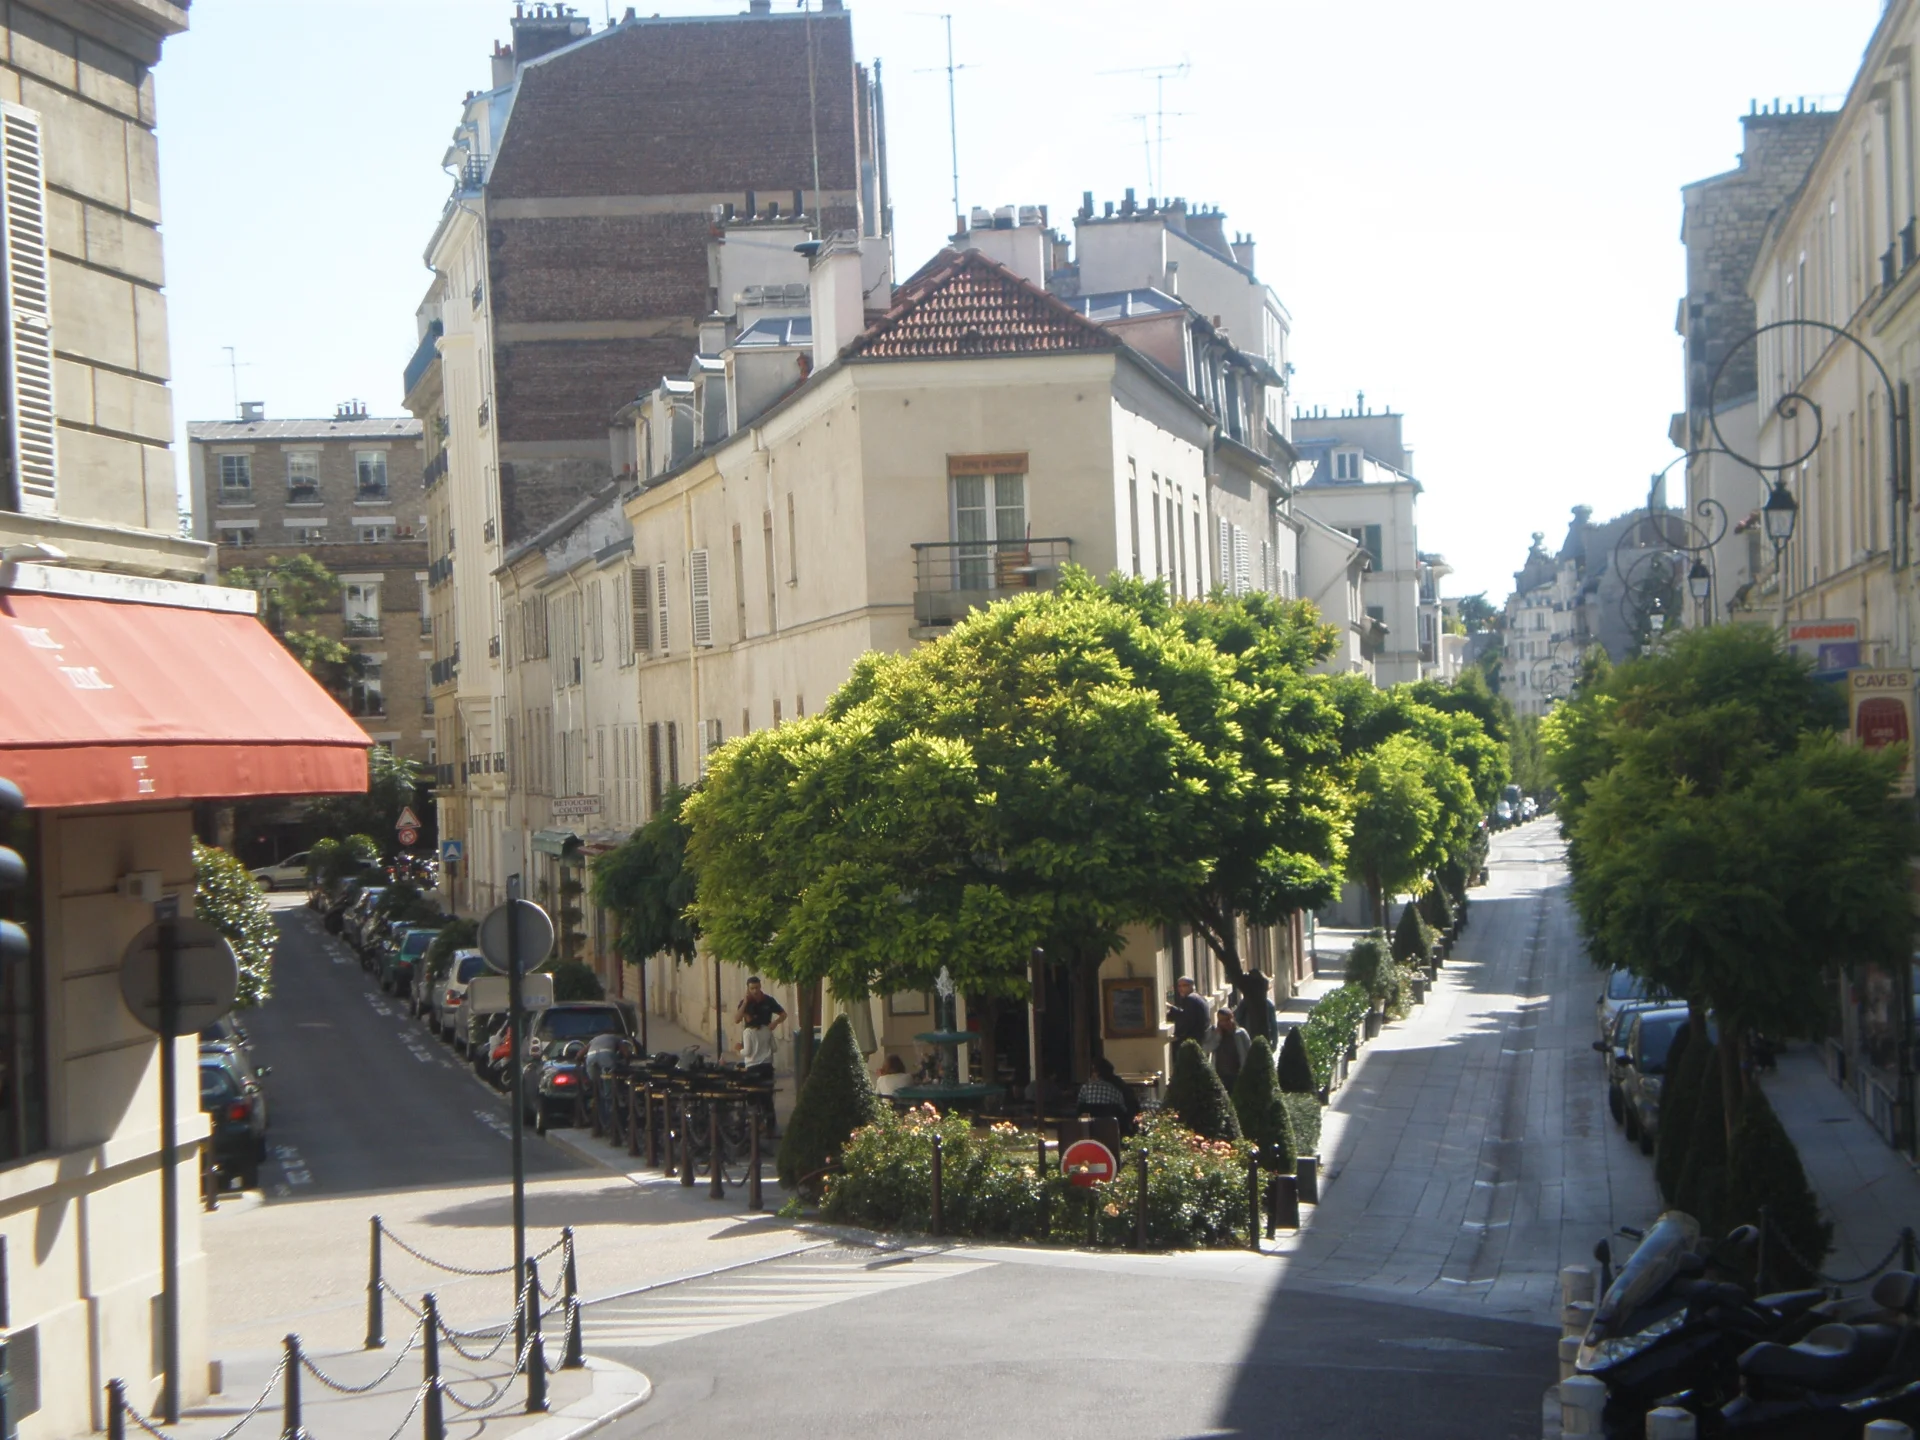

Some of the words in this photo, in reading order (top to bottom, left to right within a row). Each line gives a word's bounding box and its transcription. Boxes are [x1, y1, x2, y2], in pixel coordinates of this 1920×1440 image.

[1854, 673, 1908, 688] CAVES
[554, 799, 598, 807] RETOUCHES
[558, 806, 593, 814] COUTURE
